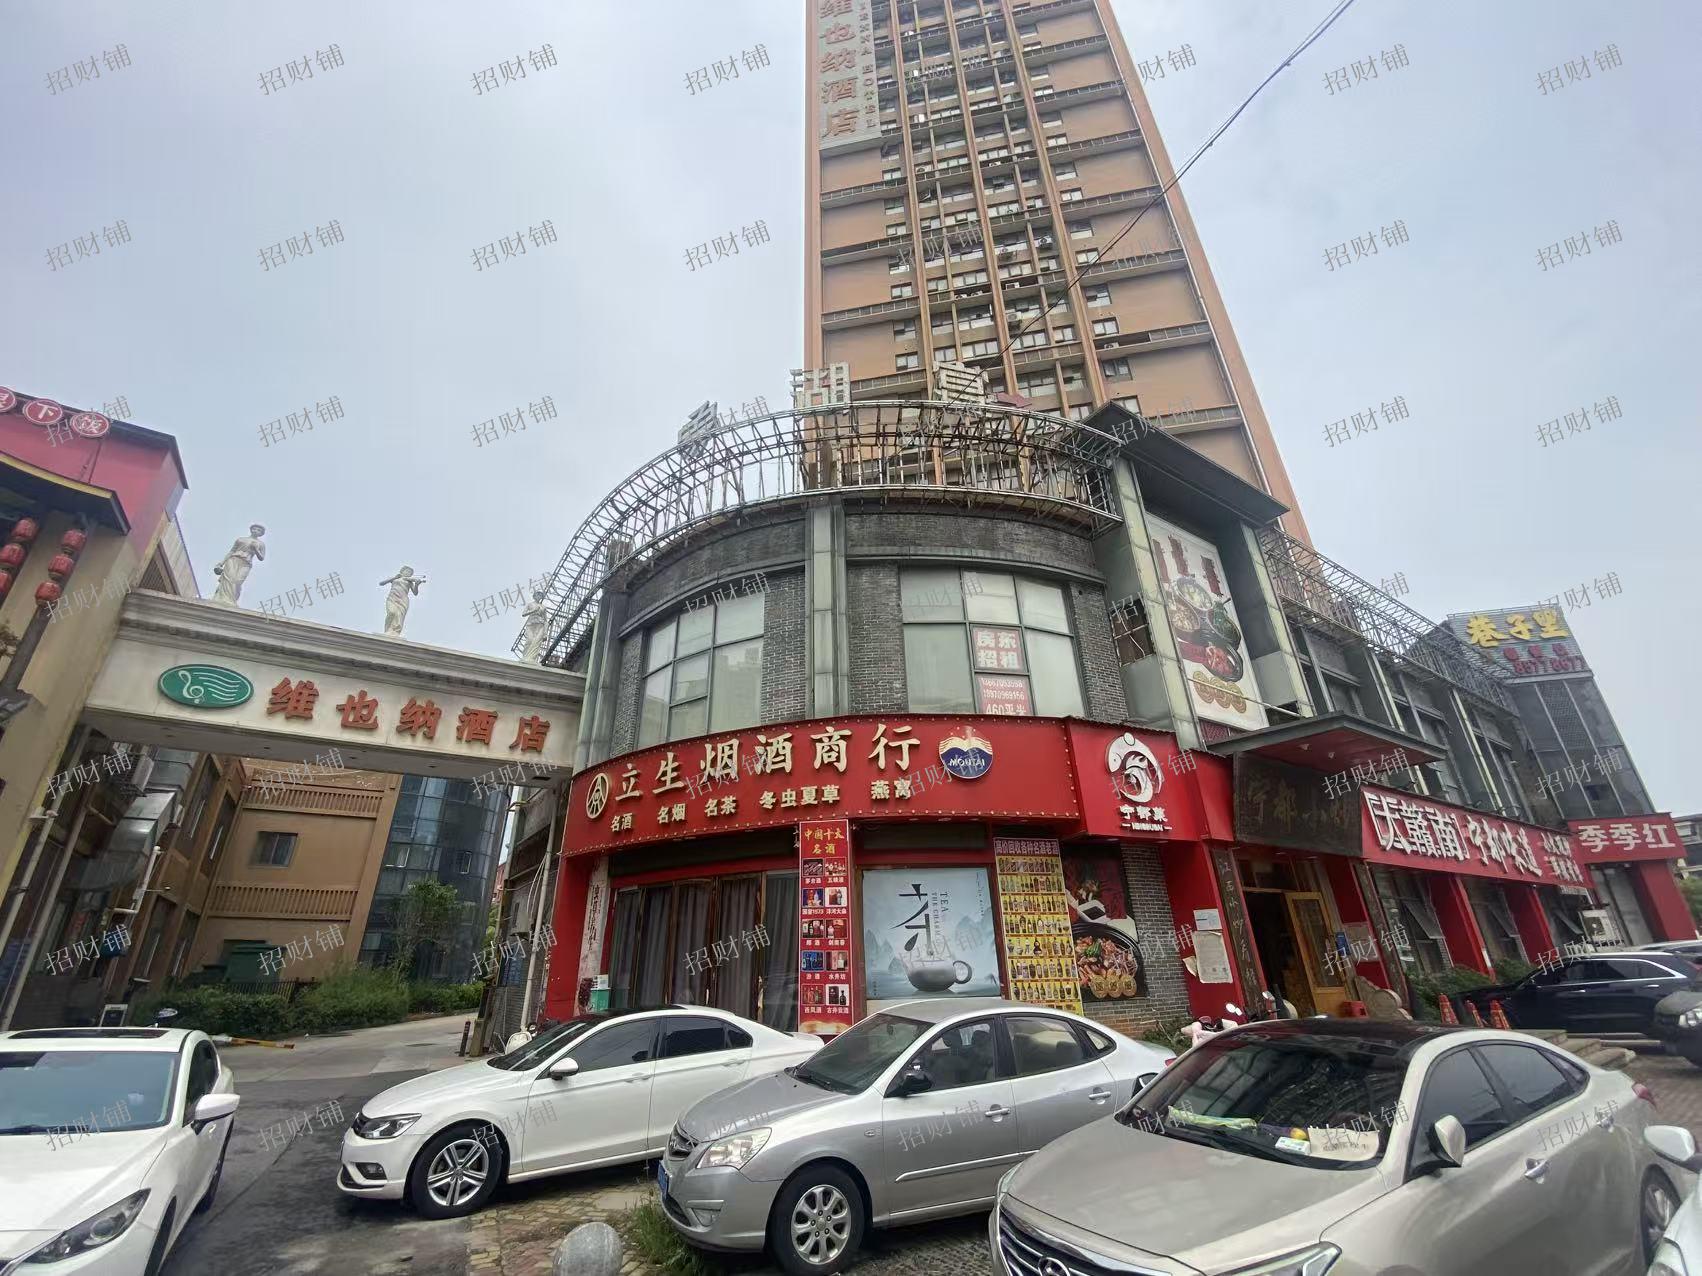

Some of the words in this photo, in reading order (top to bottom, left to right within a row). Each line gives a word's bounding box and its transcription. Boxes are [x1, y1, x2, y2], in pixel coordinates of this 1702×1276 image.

[266, 677, 552, 755] 维也纳酒店
[615, 722, 921, 802] 立生烟酒商行
[611, 812, 634, 832] 名酒
[657, 803, 687, 824] 名烟
[704, 796, 737, 817] 名茶
[759, 784, 840, 810] 冬虫夏草
[804, 827, 845, 841] 中国十大
[812, 843, 836, 855] 名酒
[1578, 822, 1677, 853] 季季红
[940, 891, 949, 912] TEA
